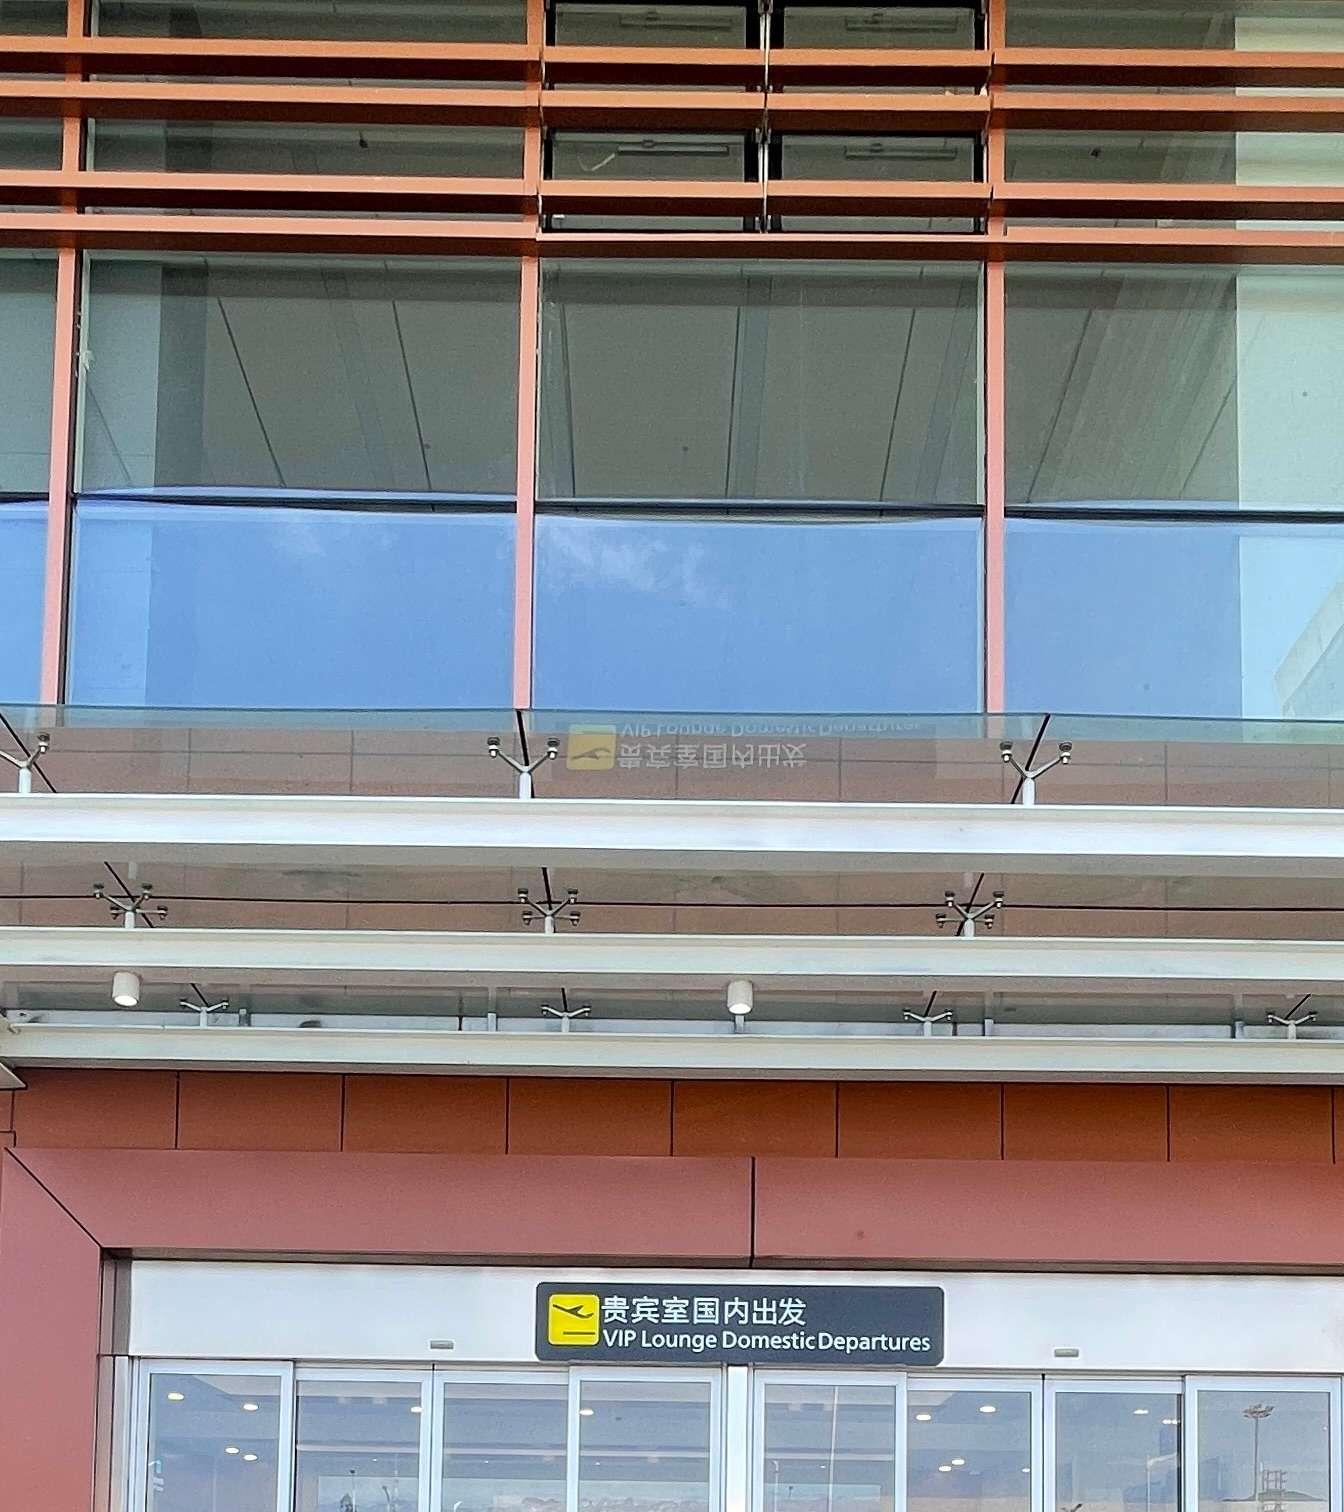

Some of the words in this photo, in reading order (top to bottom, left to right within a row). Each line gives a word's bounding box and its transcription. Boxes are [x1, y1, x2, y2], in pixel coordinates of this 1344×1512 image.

[601, 1295, 806, 1326] 贵宾室国内出发
[602, 1329, 637, 1347] VIP
[641, 1330, 717, 1353] Lounge
[722, 1331, 815, 1350] Domestic
[818, 1332, 931, 1354] Departures
